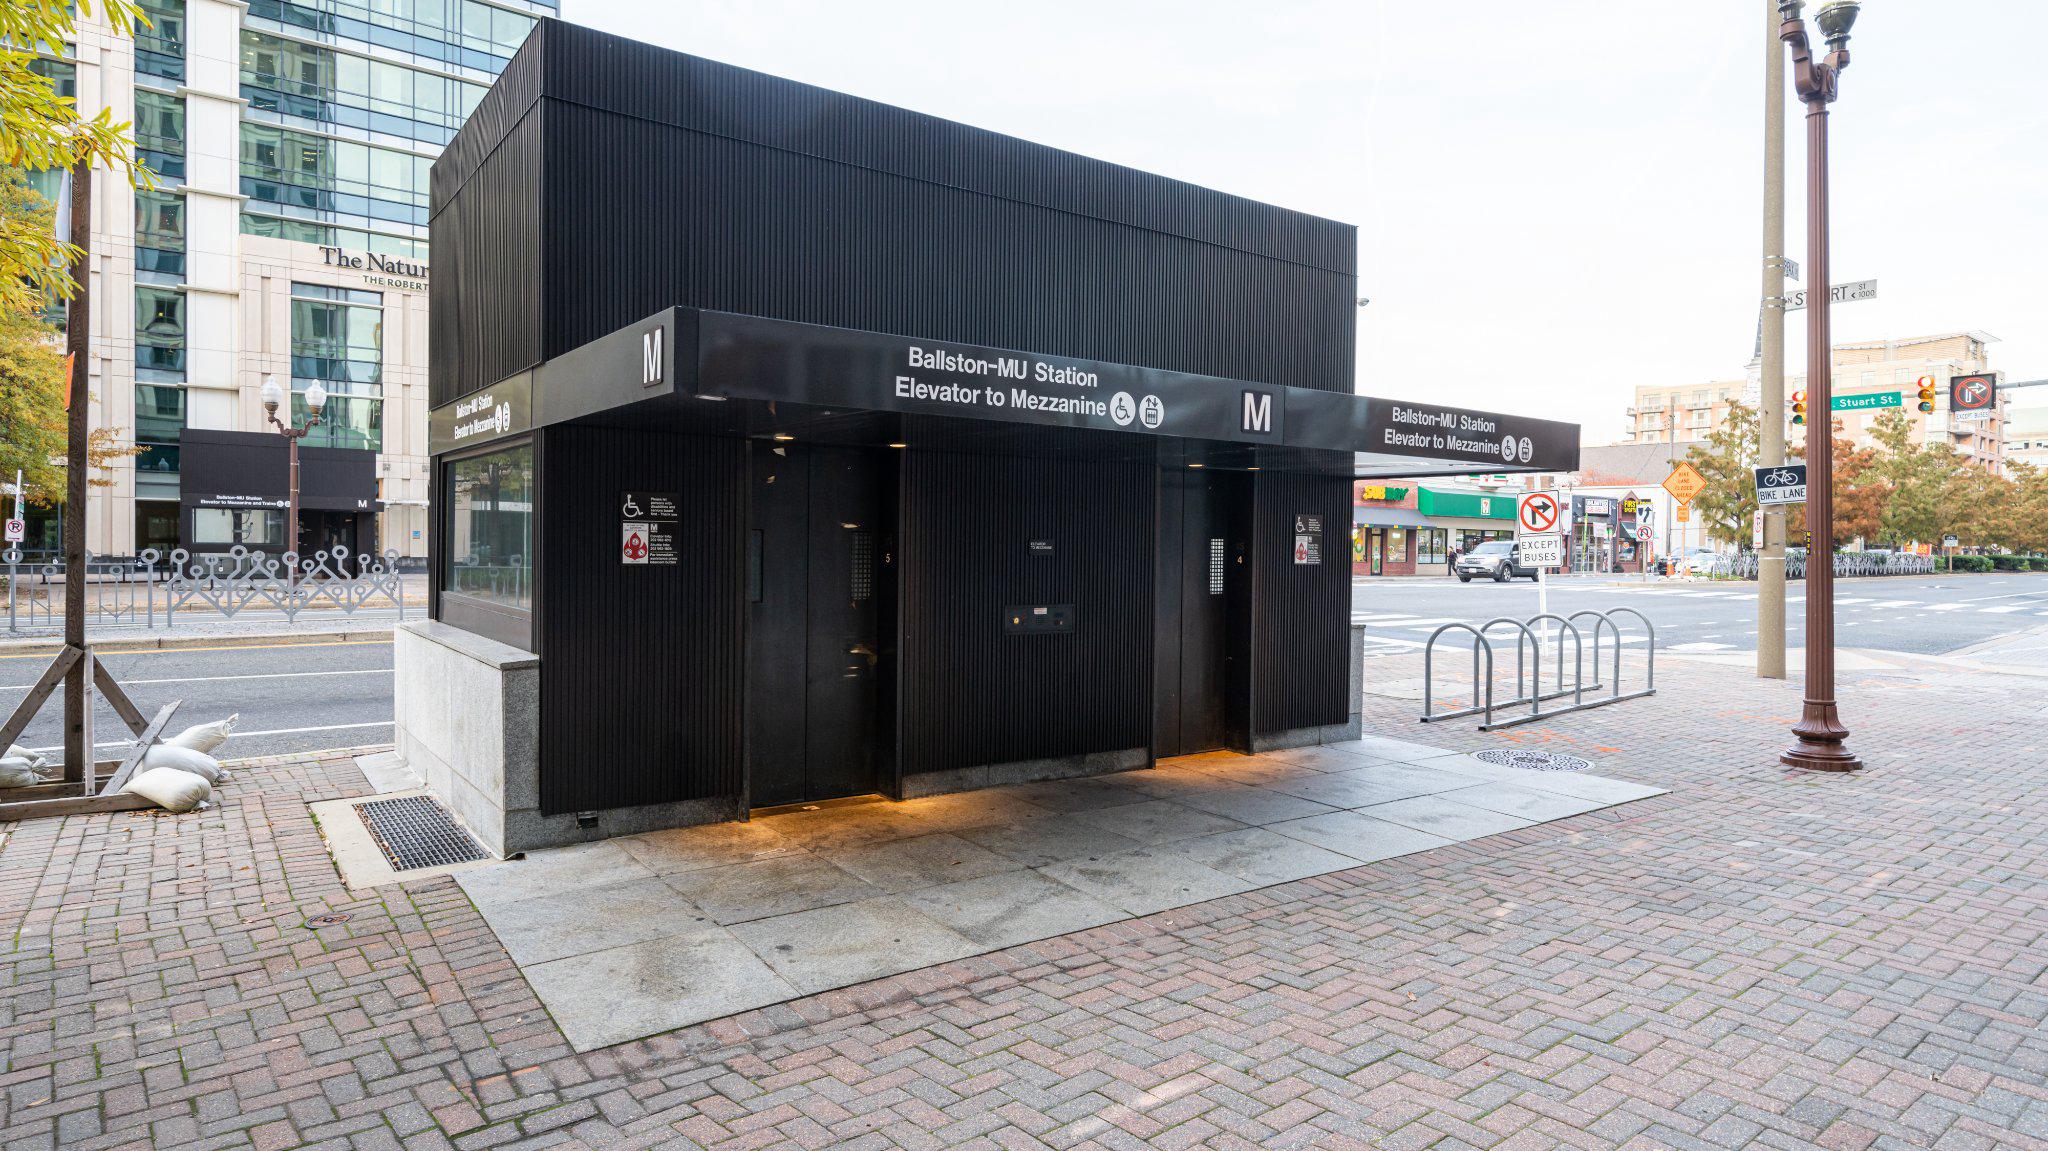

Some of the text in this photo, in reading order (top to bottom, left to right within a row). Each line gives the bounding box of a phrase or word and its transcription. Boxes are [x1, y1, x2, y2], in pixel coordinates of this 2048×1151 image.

[319, 245, 362, 269] The
[363, 275, 384, 286] THE
[643, 329, 661, 384] M
[909, 346, 1098, 388] Ballston-MU Station
[895, 375, 1107, 417] Elevator to Mezzanine
[1839, 396, 1897, 408] Stuart St.
[1244, 393, 1271, 431] M
[1392, 406, 1496, 433] Ballston-MU Station
[1384, 428, 1500, 455] Elevator to Mezzanine
[358, 500, 367, 508] M
[1760, 487, 1806, 501] BIKE LANE
[1521, 540, 1559, 550] EXCEPT
[1524, 552, 1557, 562] BUSES
